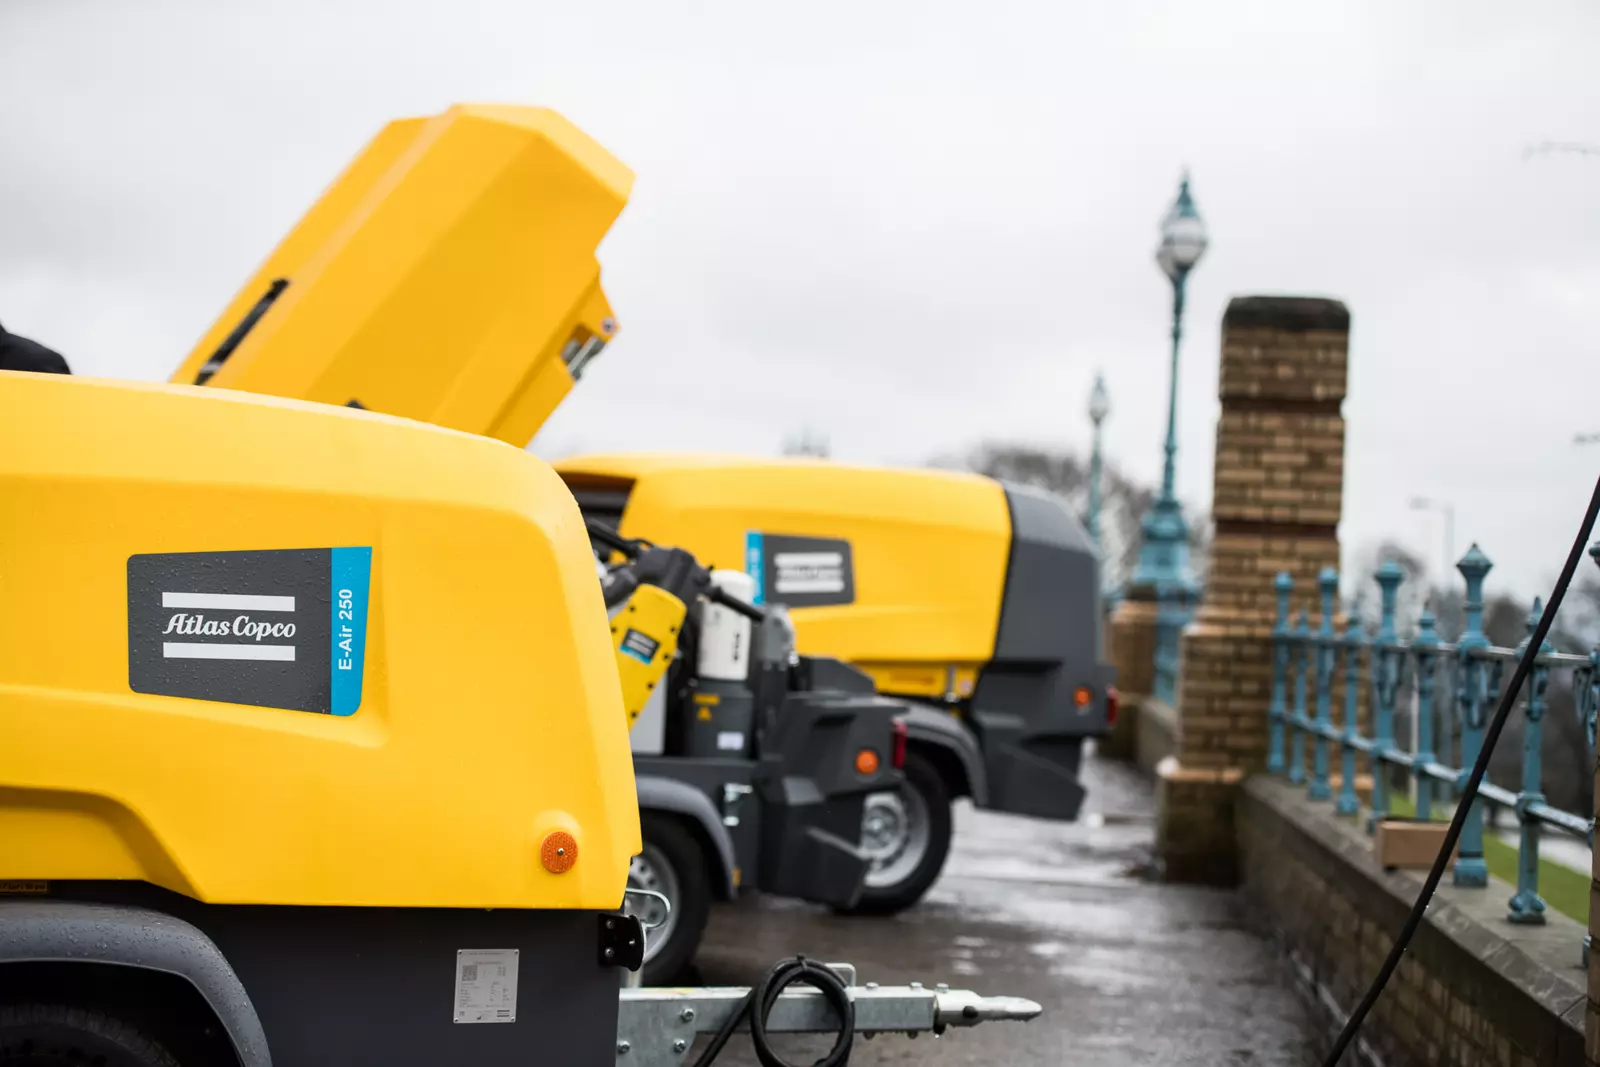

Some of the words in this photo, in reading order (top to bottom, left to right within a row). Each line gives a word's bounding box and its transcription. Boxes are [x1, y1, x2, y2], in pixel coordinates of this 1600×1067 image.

[338, 588, 353, 621] 250
[162, 613, 231, 636] Atlas
[231, 615, 296, 641] Copco
[338, 625, 352, 670] E-Air
